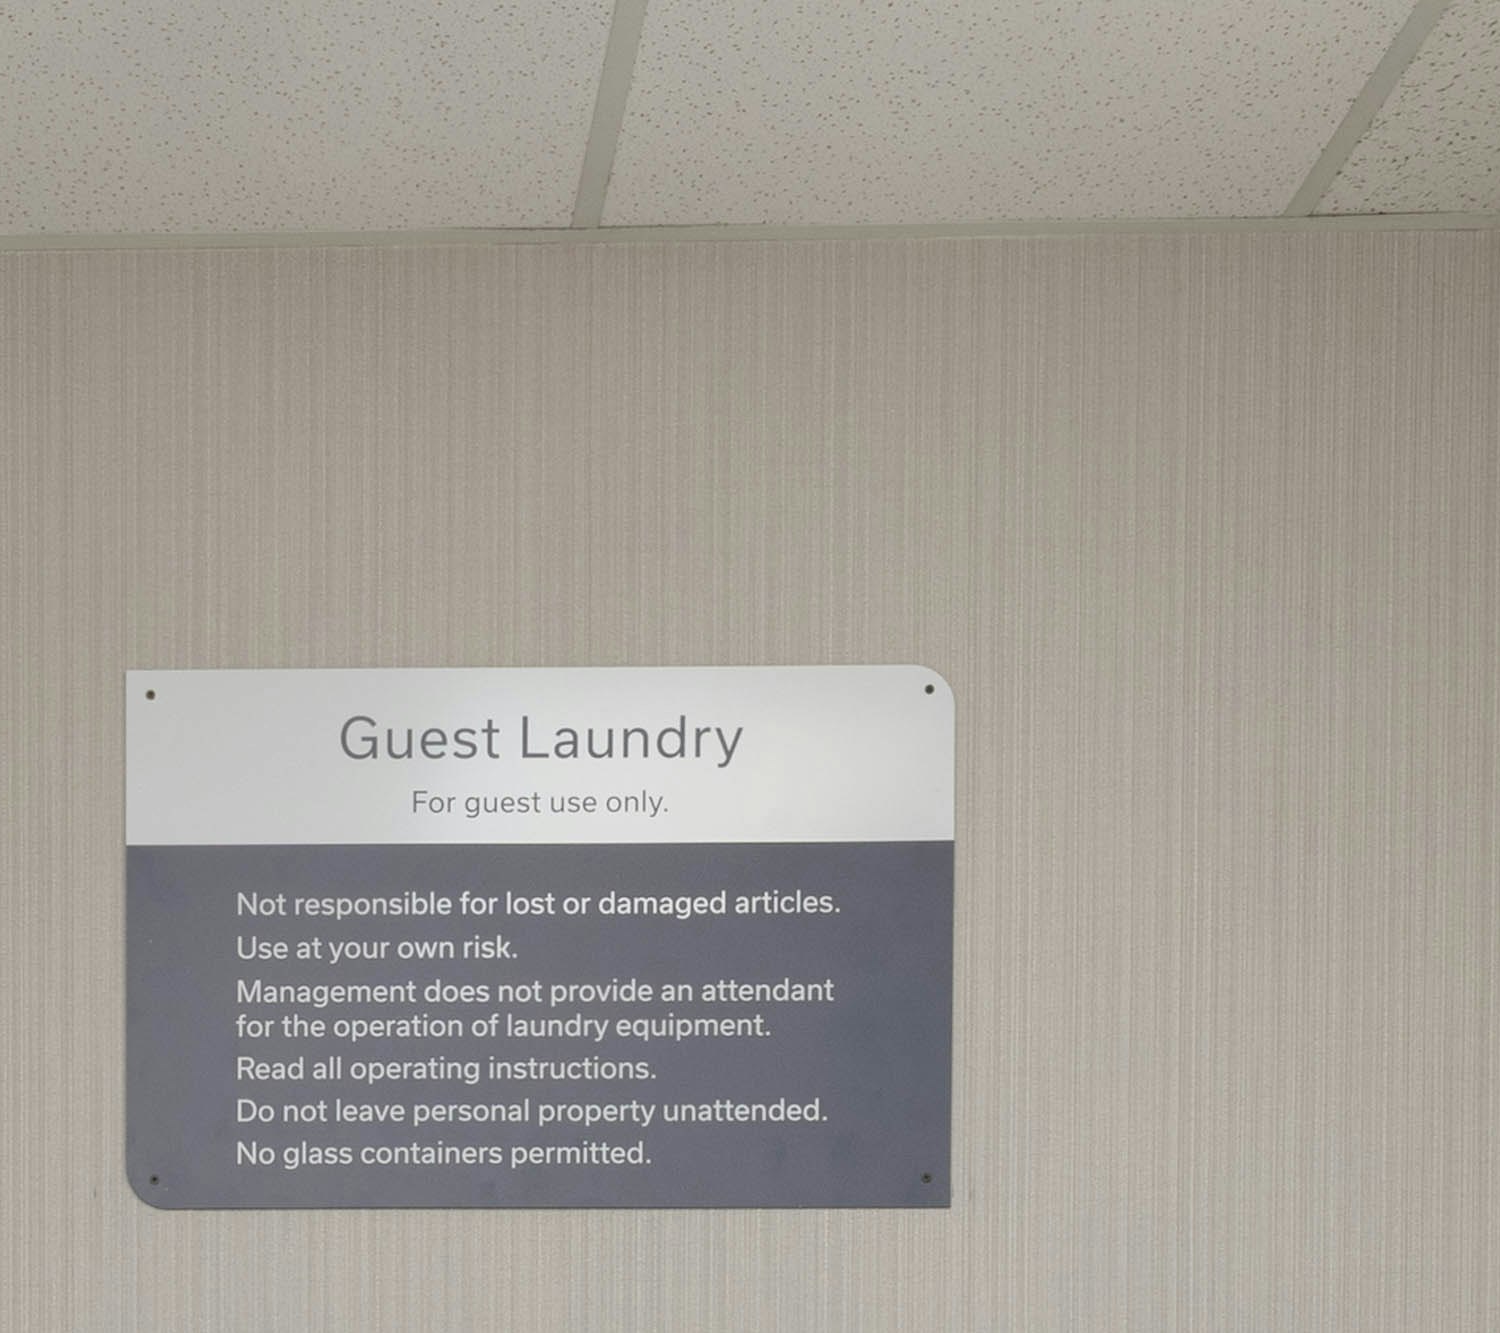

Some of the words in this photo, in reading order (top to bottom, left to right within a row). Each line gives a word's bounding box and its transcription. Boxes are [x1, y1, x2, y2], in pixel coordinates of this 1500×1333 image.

[339, 714, 500, 761] Guest
[521, 714, 744, 769] Laundry
[412, 790, 457, 814] For
[464, 791, 541, 819] guest
[550, 796, 597, 813] use
[606, 789, 669, 818] only.
[237, 892, 287, 916] Not
[294, 890, 453, 921] responsible
[458, 890, 499, 916] for
[506, 890, 556, 916] lost
[562, 896, 592, 915] or
[598, 889, 727, 920] damaged
[734, 889, 841, 915] articles.
[237, 935, 289, 960] Use
[296, 936, 323, 960] at
[328, 941, 391, 965] your
[397, 940, 455, 960] own
[463, 934, 518, 959] risk.
[237, 979, 417, 1009] Management
[423, 978, 491, 1003] does
[498, 980, 543, 1003] not
[550, 977, 654, 1008] provide
[660, 984, 693, 1002] an
[701, 977, 835, 1002] attendant
[235, 1013, 275, 1038] for
[281, 1013, 326, 1038] the
[333, 1013, 463, 1043] operation
[471, 1012, 500, 1038] of
[507, 1012, 610, 1043] laundry
[615, 1012, 771, 1042] equipment.
[237, 1055, 304, 1081] Read
[312, 1055, 342, 1080] all
[349, 1055, 480, 1085] operating
[489, 1055, 657, 1080] instructions.
[237, 1098, 275, 1123] Do
[283, 1100, 328, 1123] not
[335, 1098, 406, 1122] leave
[413, 1098, 530, 1127] personal
[538, 1099, 657, 1128] property
[663, 1097, 828, 1122] unattended.
[236, 1140, 276, 1165] No
[283, 1140, 354, 1170] glass
[360, 1140, 503, 1165] containers
[511, 1140, 652, 1169] permitted.
